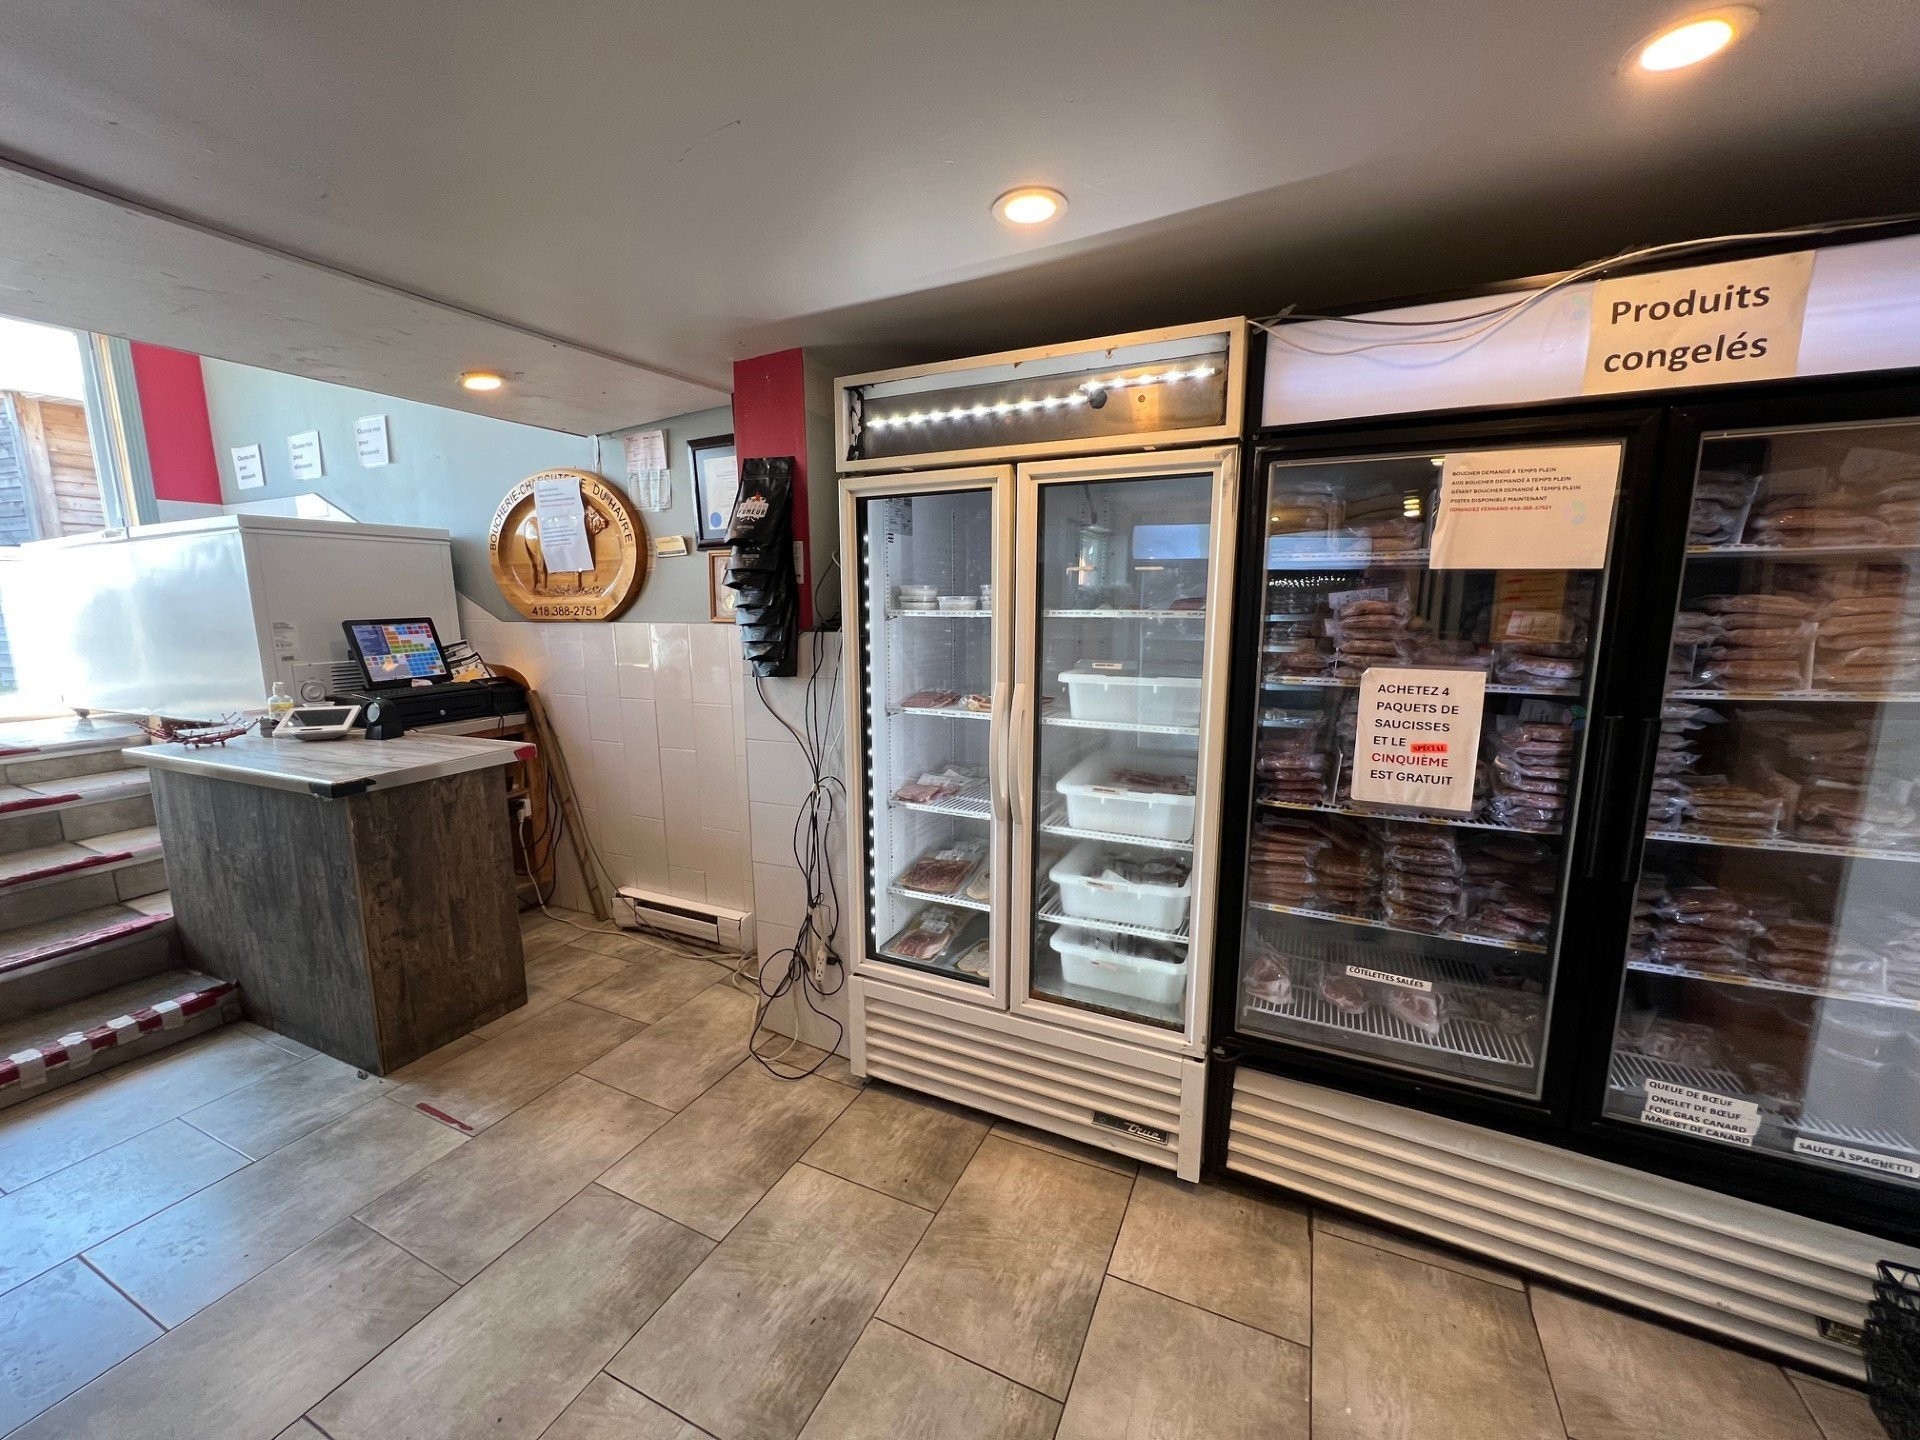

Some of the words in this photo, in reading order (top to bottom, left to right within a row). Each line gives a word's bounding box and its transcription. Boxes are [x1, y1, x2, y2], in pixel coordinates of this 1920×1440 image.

[1611, 284, 1770, 324] Produits
[1604, 331, 1768, 373] congelés
[592, 482, 608, 501] DU
[608, 499, 633, 543] HAVRE
[1377, 684, 1439, 696] ACHETEZ
[1442, 687, 1450, 696] 4
[1376, 701, 1437, 713] PAQUETS
[1441, 705, 1460, 715] DE
[1374, 718, 1450, 732] SAUCISSES
[1373, 735, 1388, 745] ET
[1391, 737, 1407, 747] LE
[1371, 752, 1449, 768] CINQUIÈME
[1370, 769, 1393, 780] EST
[1396, 771, 1453, 786] GRATUIT
[1649, 1081, 1684, 1095] QUEUE
[1686, 1090, 1700, 1099] DE
[1702, 1094, 1733, 1107] BŒUF
[1651, 1094, 1691, 1109] ONGLET
[1693, 1104, 1706, 1113] DE
[1709, 1108, 1742, 1120] BŒUF
[1645, 1114, 1688, 1129] MAGRET
[1690, 1124, 1702, 1133] DE
[1705, 1129, 1750, 1144] CANARD
[1649, 1104, 1672, 1116] FOIE
[1673, 1111, 1700, 1123] GRAS
[1703, 1118, 1747, 1133] CANARD
[1799, 1142, 1835, 1156] SAUCE
[1838, 1148, 1846, 1158] À
[1849, 1153, 1914, 1173] SPAGHETTI
